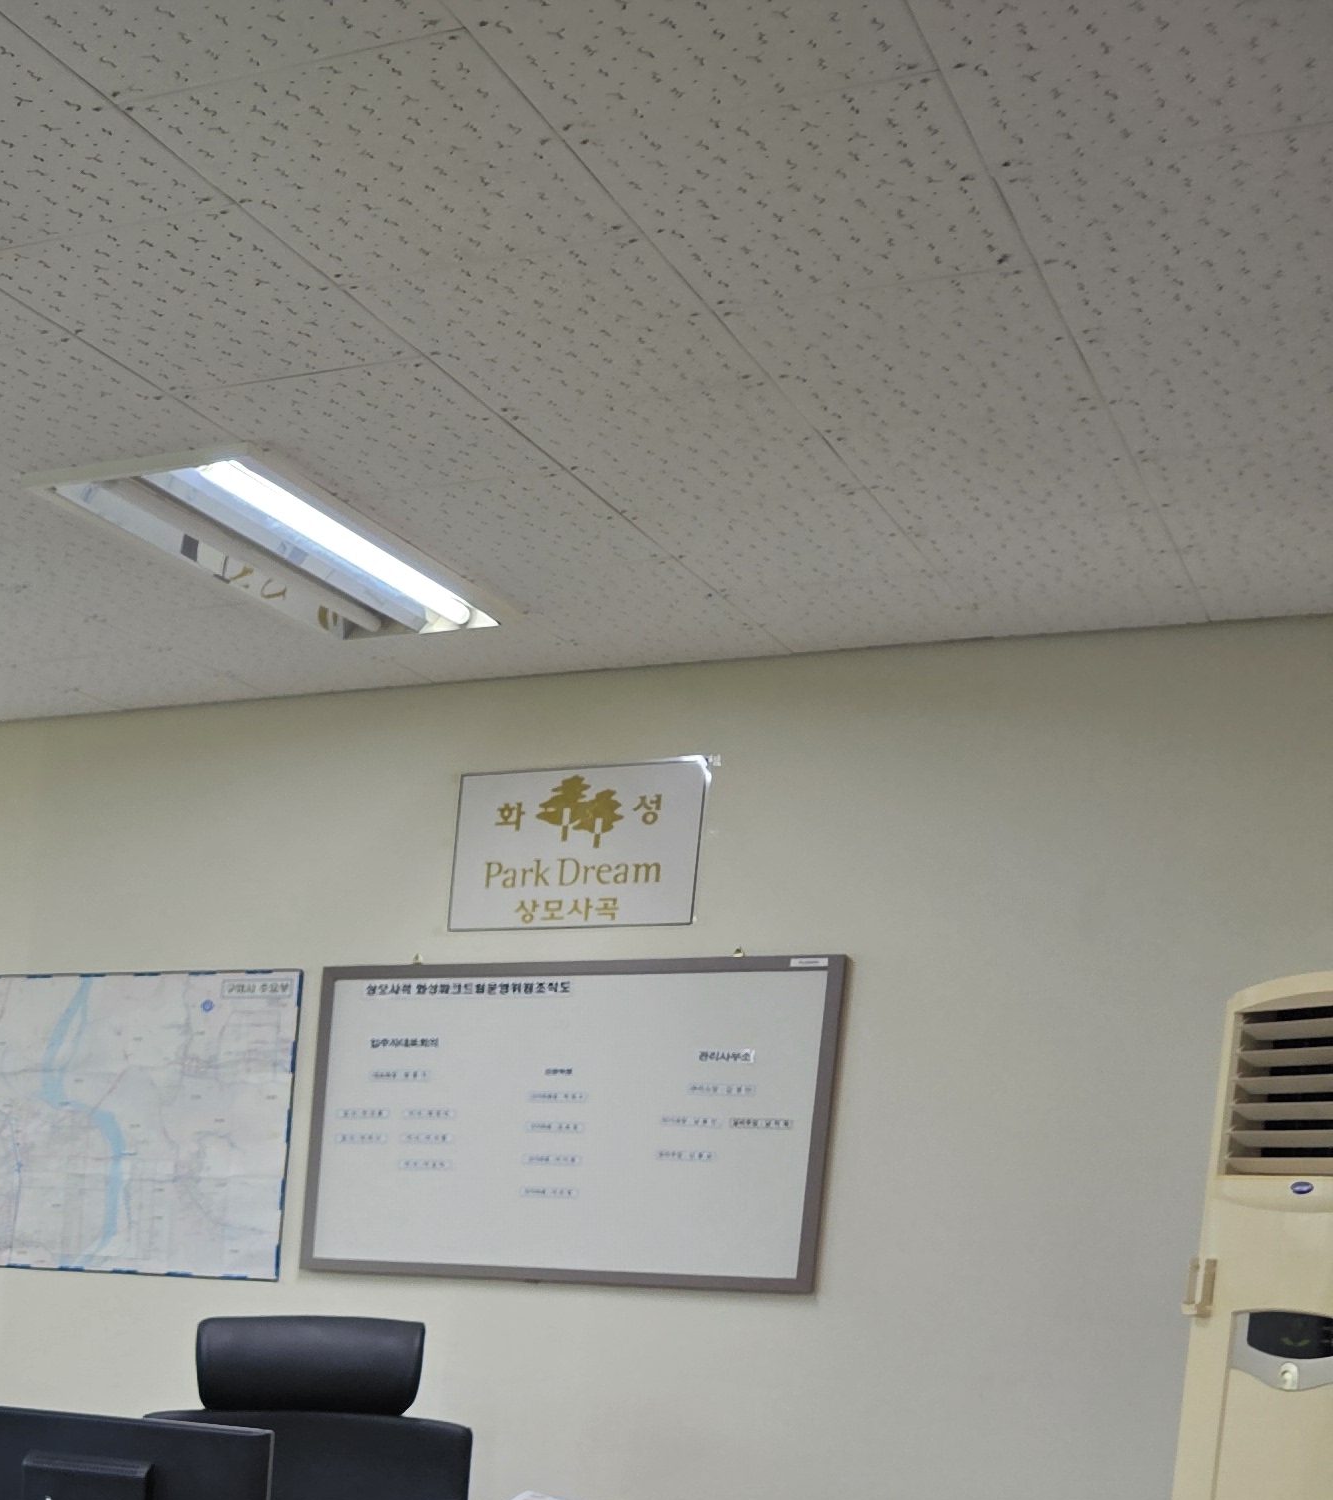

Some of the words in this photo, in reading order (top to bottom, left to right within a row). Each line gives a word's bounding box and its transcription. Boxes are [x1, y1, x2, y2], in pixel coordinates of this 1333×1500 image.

[494, 801, 526, 832] 화
[632, 793, 663, 826] 성
[484, 858, 550, 889] Park
[557, 857, 662, 887] Dream
[514, 896, 620, 925] 상모사곡
[698, 1050, 751, 1063] 관리사무소
